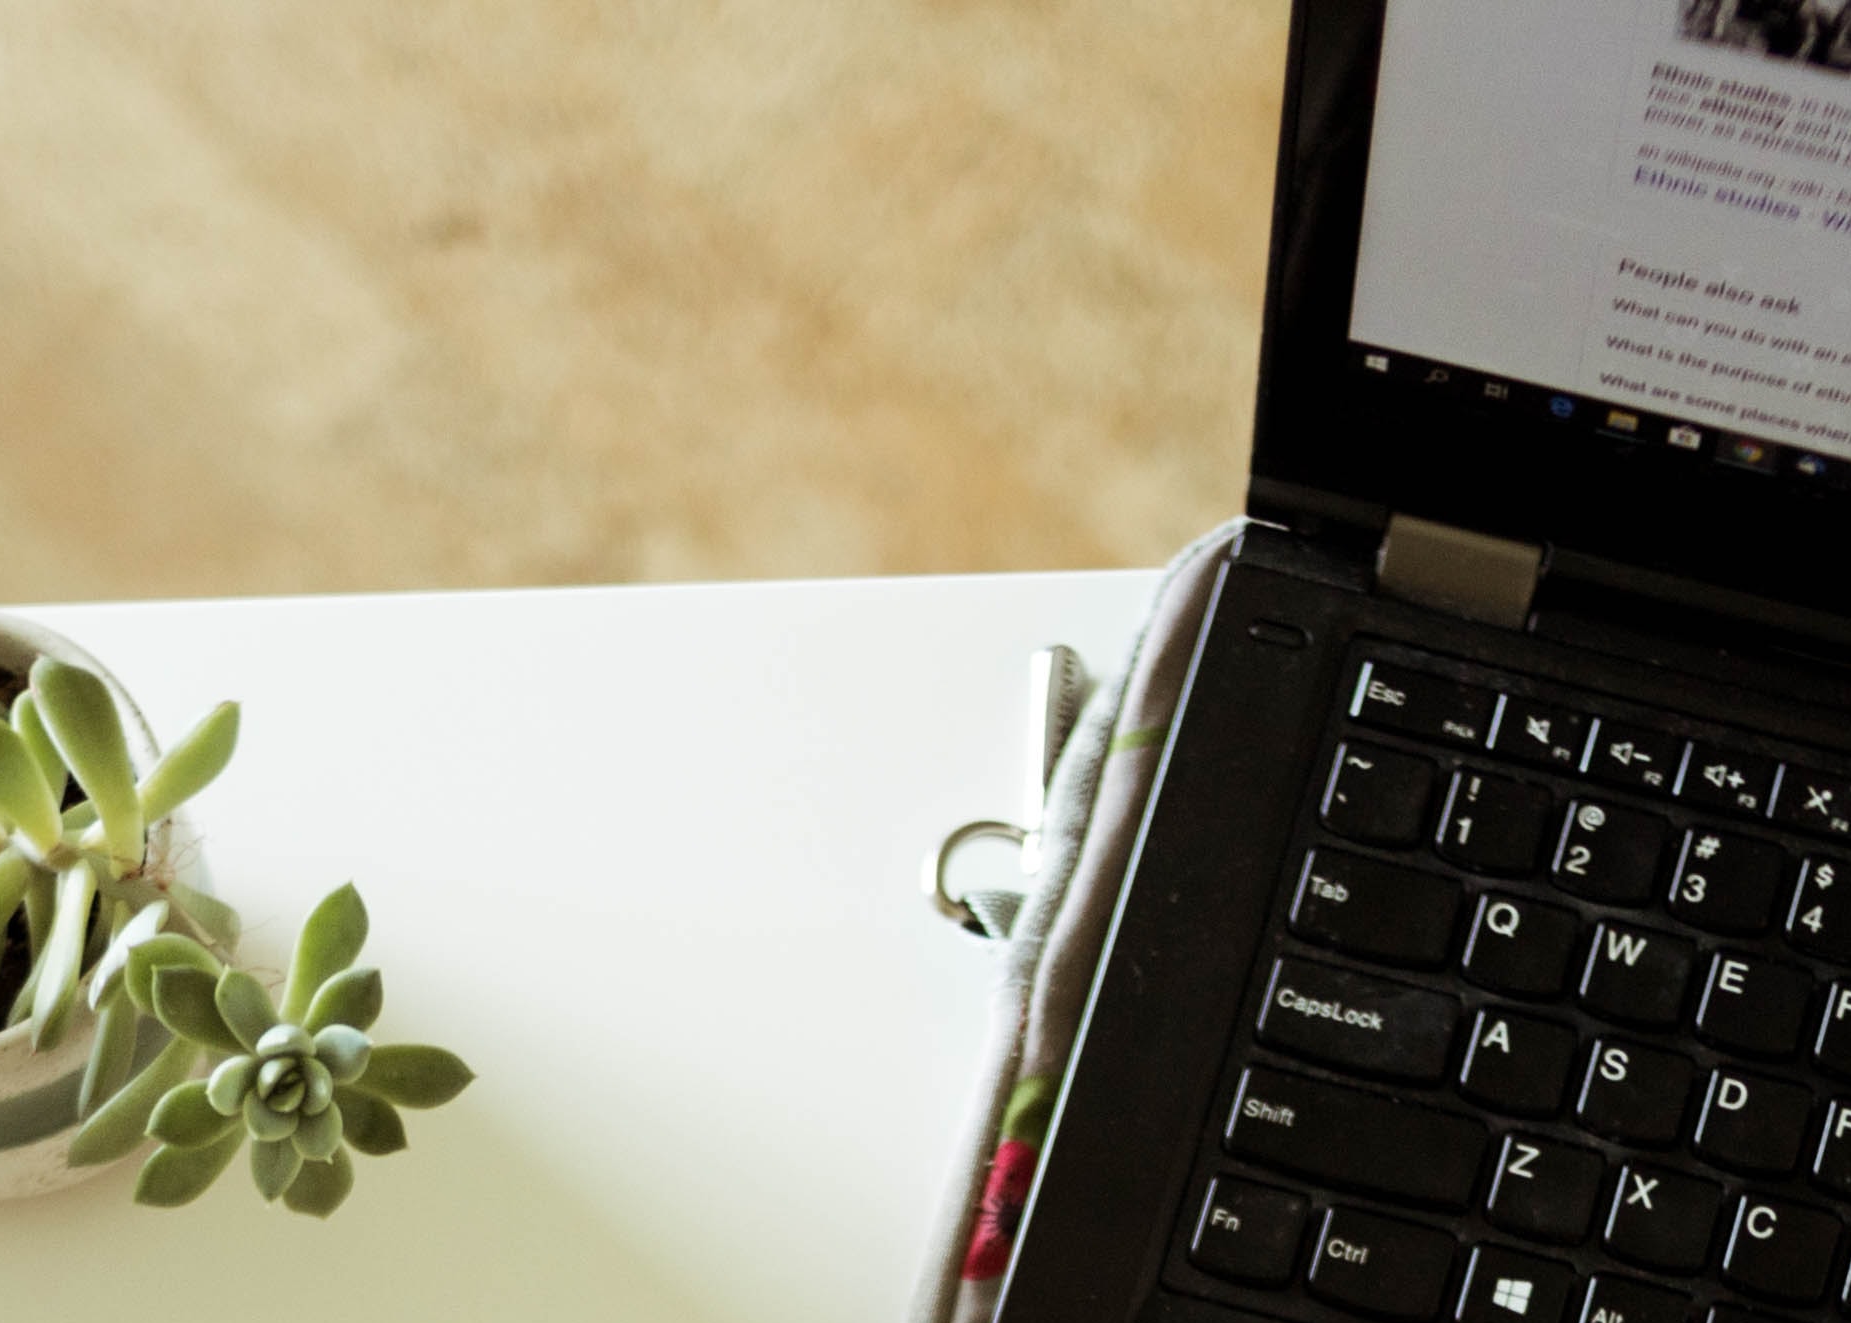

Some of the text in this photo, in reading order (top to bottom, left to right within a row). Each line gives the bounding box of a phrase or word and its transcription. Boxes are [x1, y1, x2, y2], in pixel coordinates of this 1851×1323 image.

[1619, 257, 1801, 316] People also ask
[1366, 680, 1407, 710] Esc
[1310, 875, 1351, 904] Tab
[1487, 903, 1521, 938] Q
[1607, 934, 1647, 967] W
[1718, 960, 1750, 993] E
[1276, 986, 1384, 1034] CapsLock
[1242, 1097, 1297, 1129] Shift
[1210, 1208, 1241, 1233] Fn
[1326, 1236, 1369, 1266] Ctrl
